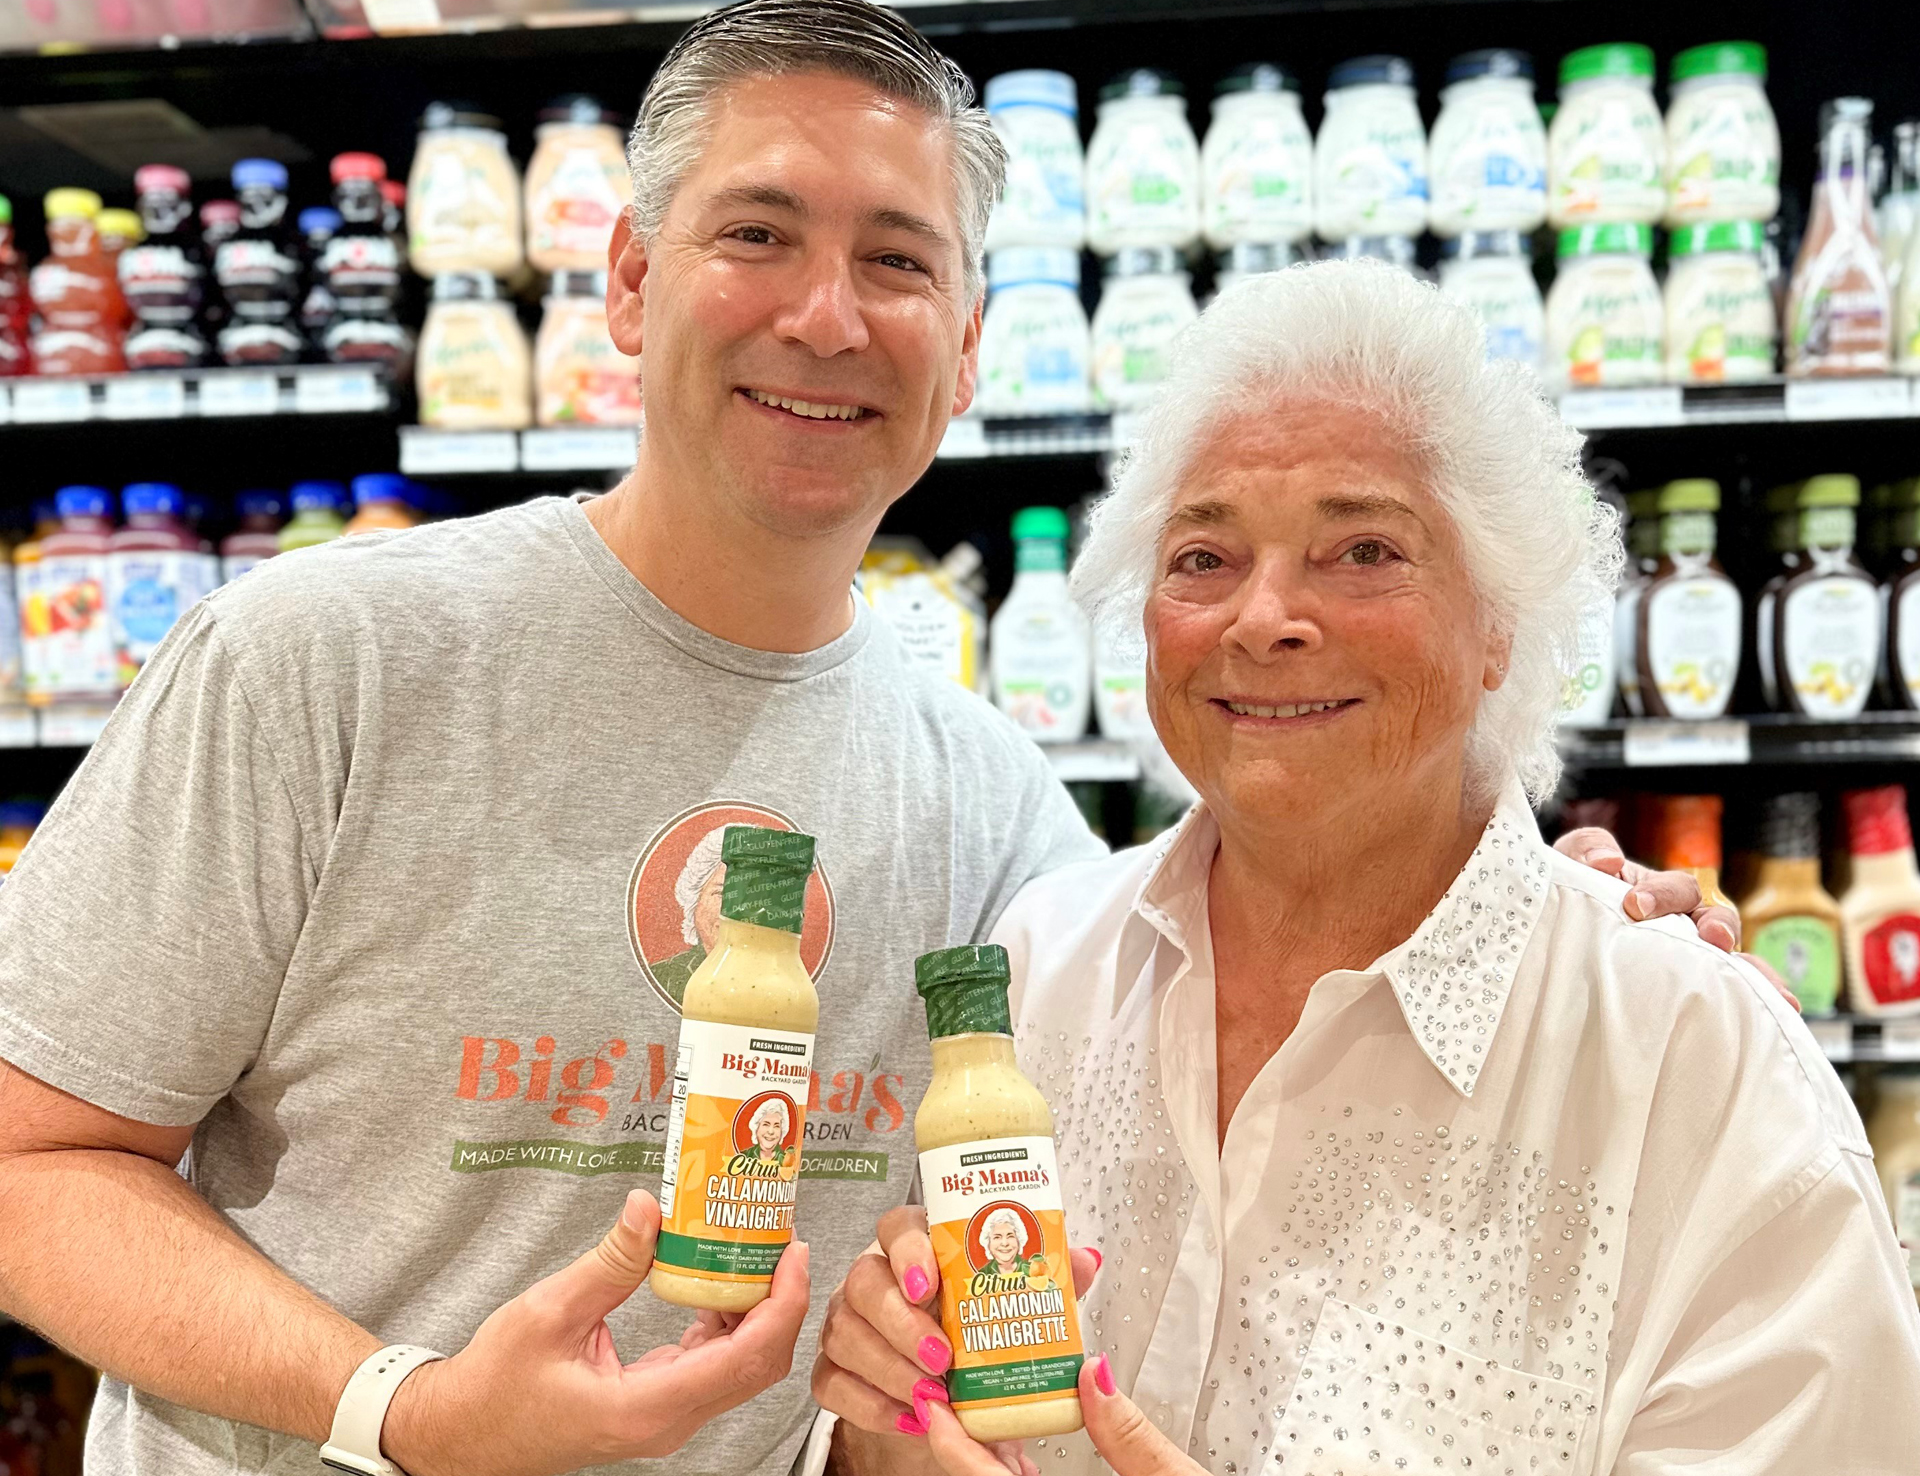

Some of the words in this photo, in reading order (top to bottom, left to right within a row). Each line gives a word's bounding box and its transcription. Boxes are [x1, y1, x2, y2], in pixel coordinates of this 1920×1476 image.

[752, 1041, 773, 1050] FRESH
[721, 1053, 760, 1079] Big
[454, 1035, 628, 1127] Big
[761, 1075, 791, 1084] BACKYARD
[459, 1147, 517, 1166] MADE
[520, 1146, 574, 1165] WITH
[727, 1154, 779, 1178] Citrus
[962, 1154, 984, 1164] FRESH
[984, 1150, 1026, 1161] INGREDIENTS
[941, 1171, 975, 1196] Big
[978, 1163, 1050, 1187] Mama's
[980, 1185, 1016, 1194] BACKYARD
[1017, 1183, 1041, 1191] GARDEN
[704, 1200, 795, 1230] VINAIGRETTE
[971, 1273, 1027, 1298] Citrus
[958, 1288, 1065, 1325] CALAMONDIN
[961, 1315, 1069, 1353] VINAIGRETTE
